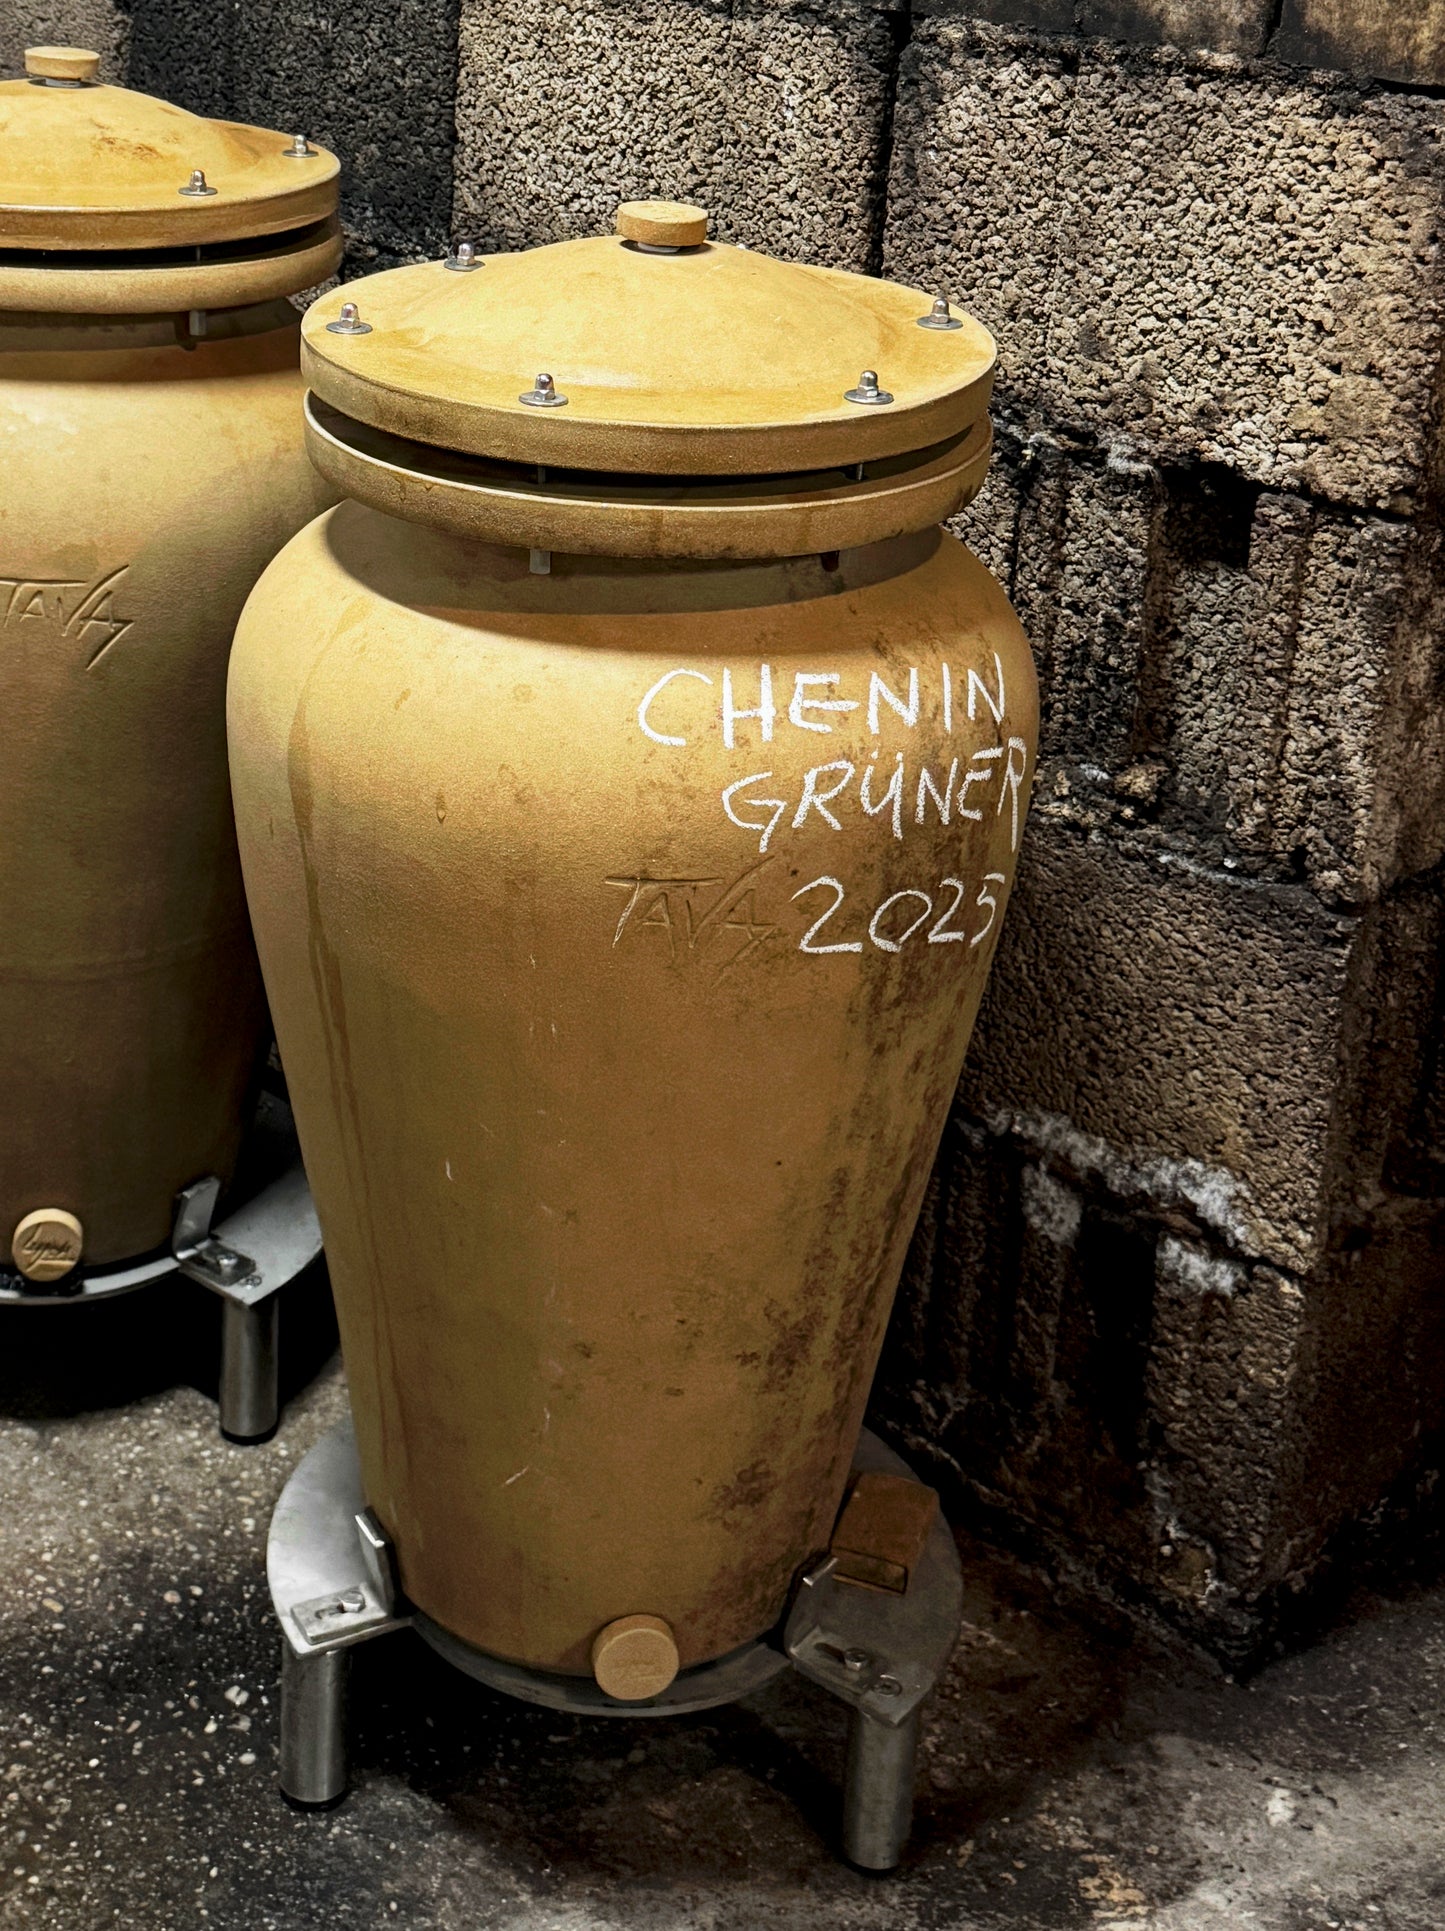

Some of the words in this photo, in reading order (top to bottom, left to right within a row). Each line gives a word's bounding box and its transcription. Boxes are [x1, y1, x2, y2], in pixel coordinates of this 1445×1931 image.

[637, 652, 1005, 750] CHENIN
[721, 736, 1028, 853] GRÜNER
[602, 855, 777, 988] TAVA
[790, 873, 1005, 954] 2025
